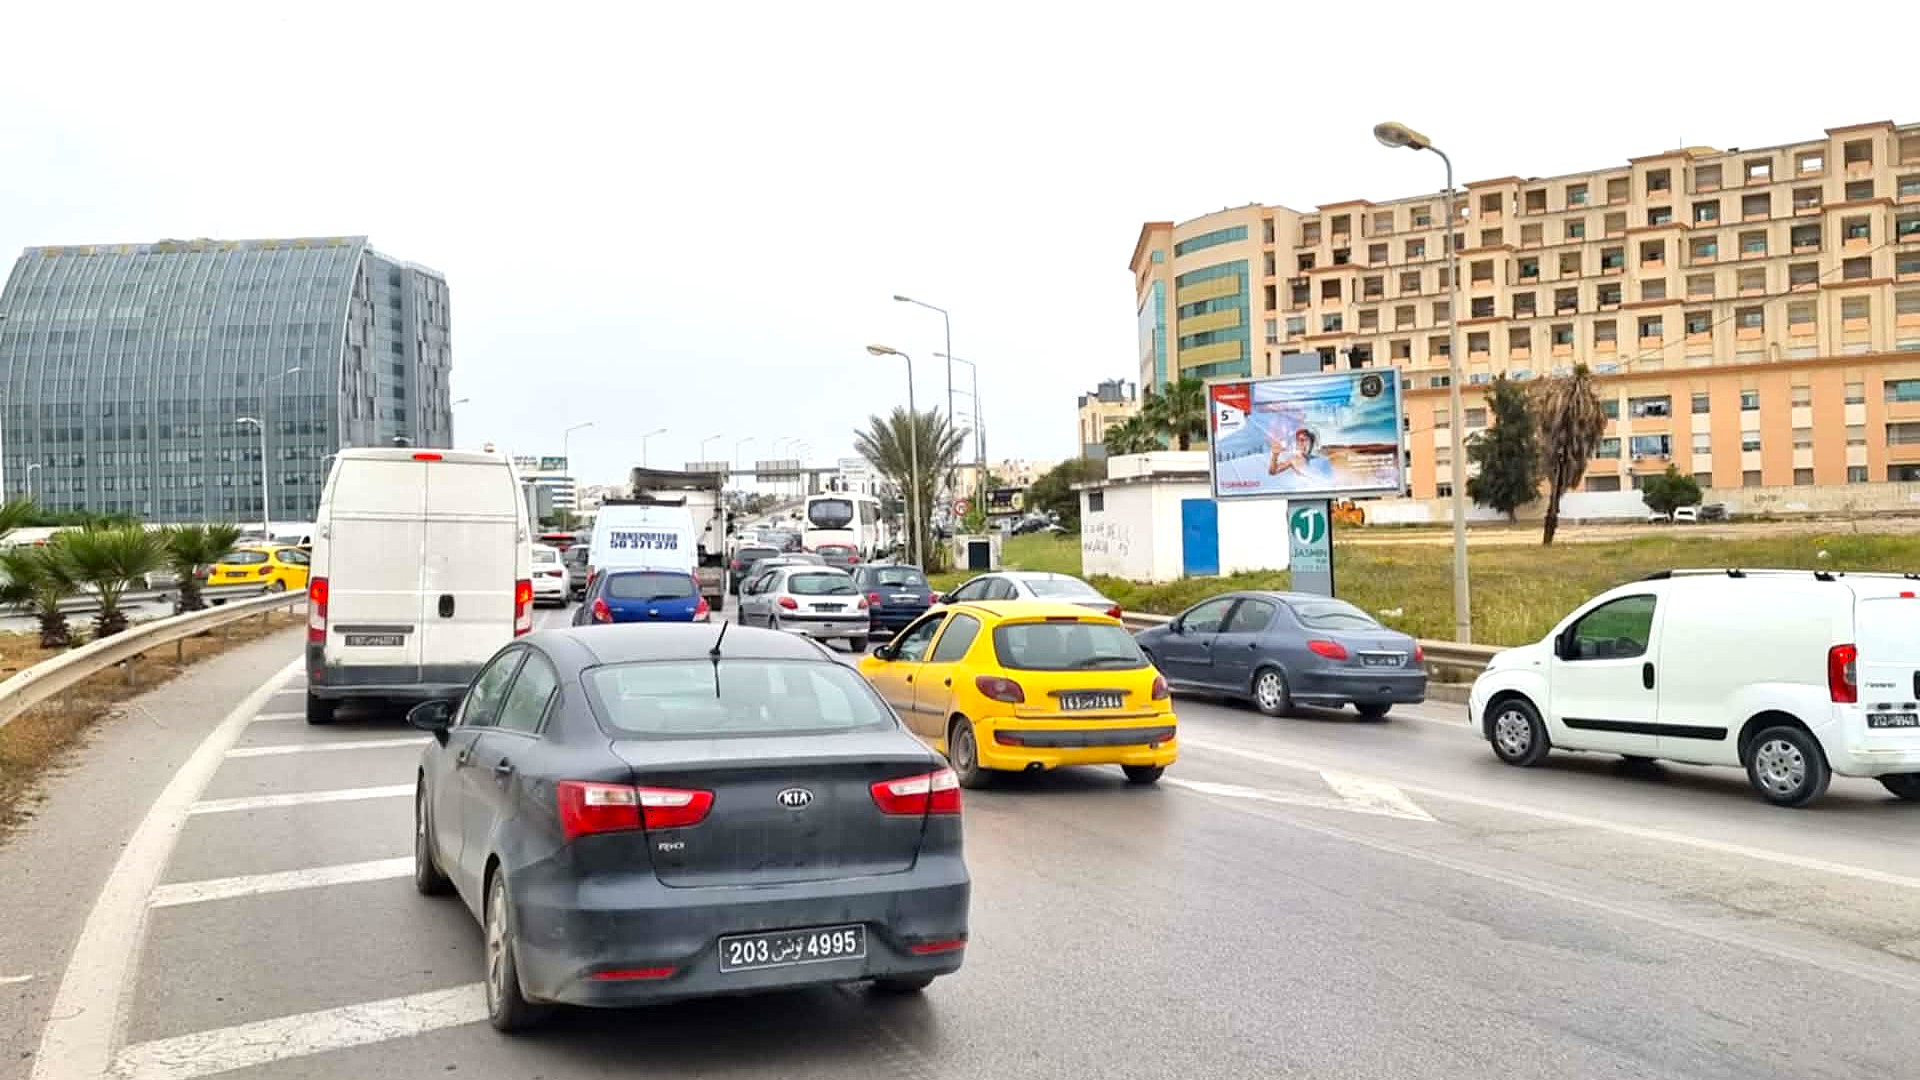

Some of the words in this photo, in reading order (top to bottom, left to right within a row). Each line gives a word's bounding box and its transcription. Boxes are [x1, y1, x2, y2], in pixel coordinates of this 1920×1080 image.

[610, 540, 627, 549] 50
[630, 540, 652, 549] 371
[654, 540, 678, 549] 370
[783, 792, 808, 804] KIA
[730, 940, 769, 965] 203
[771, 937, 804, 962] تونس
[807, 930, 857, 957] 4995
